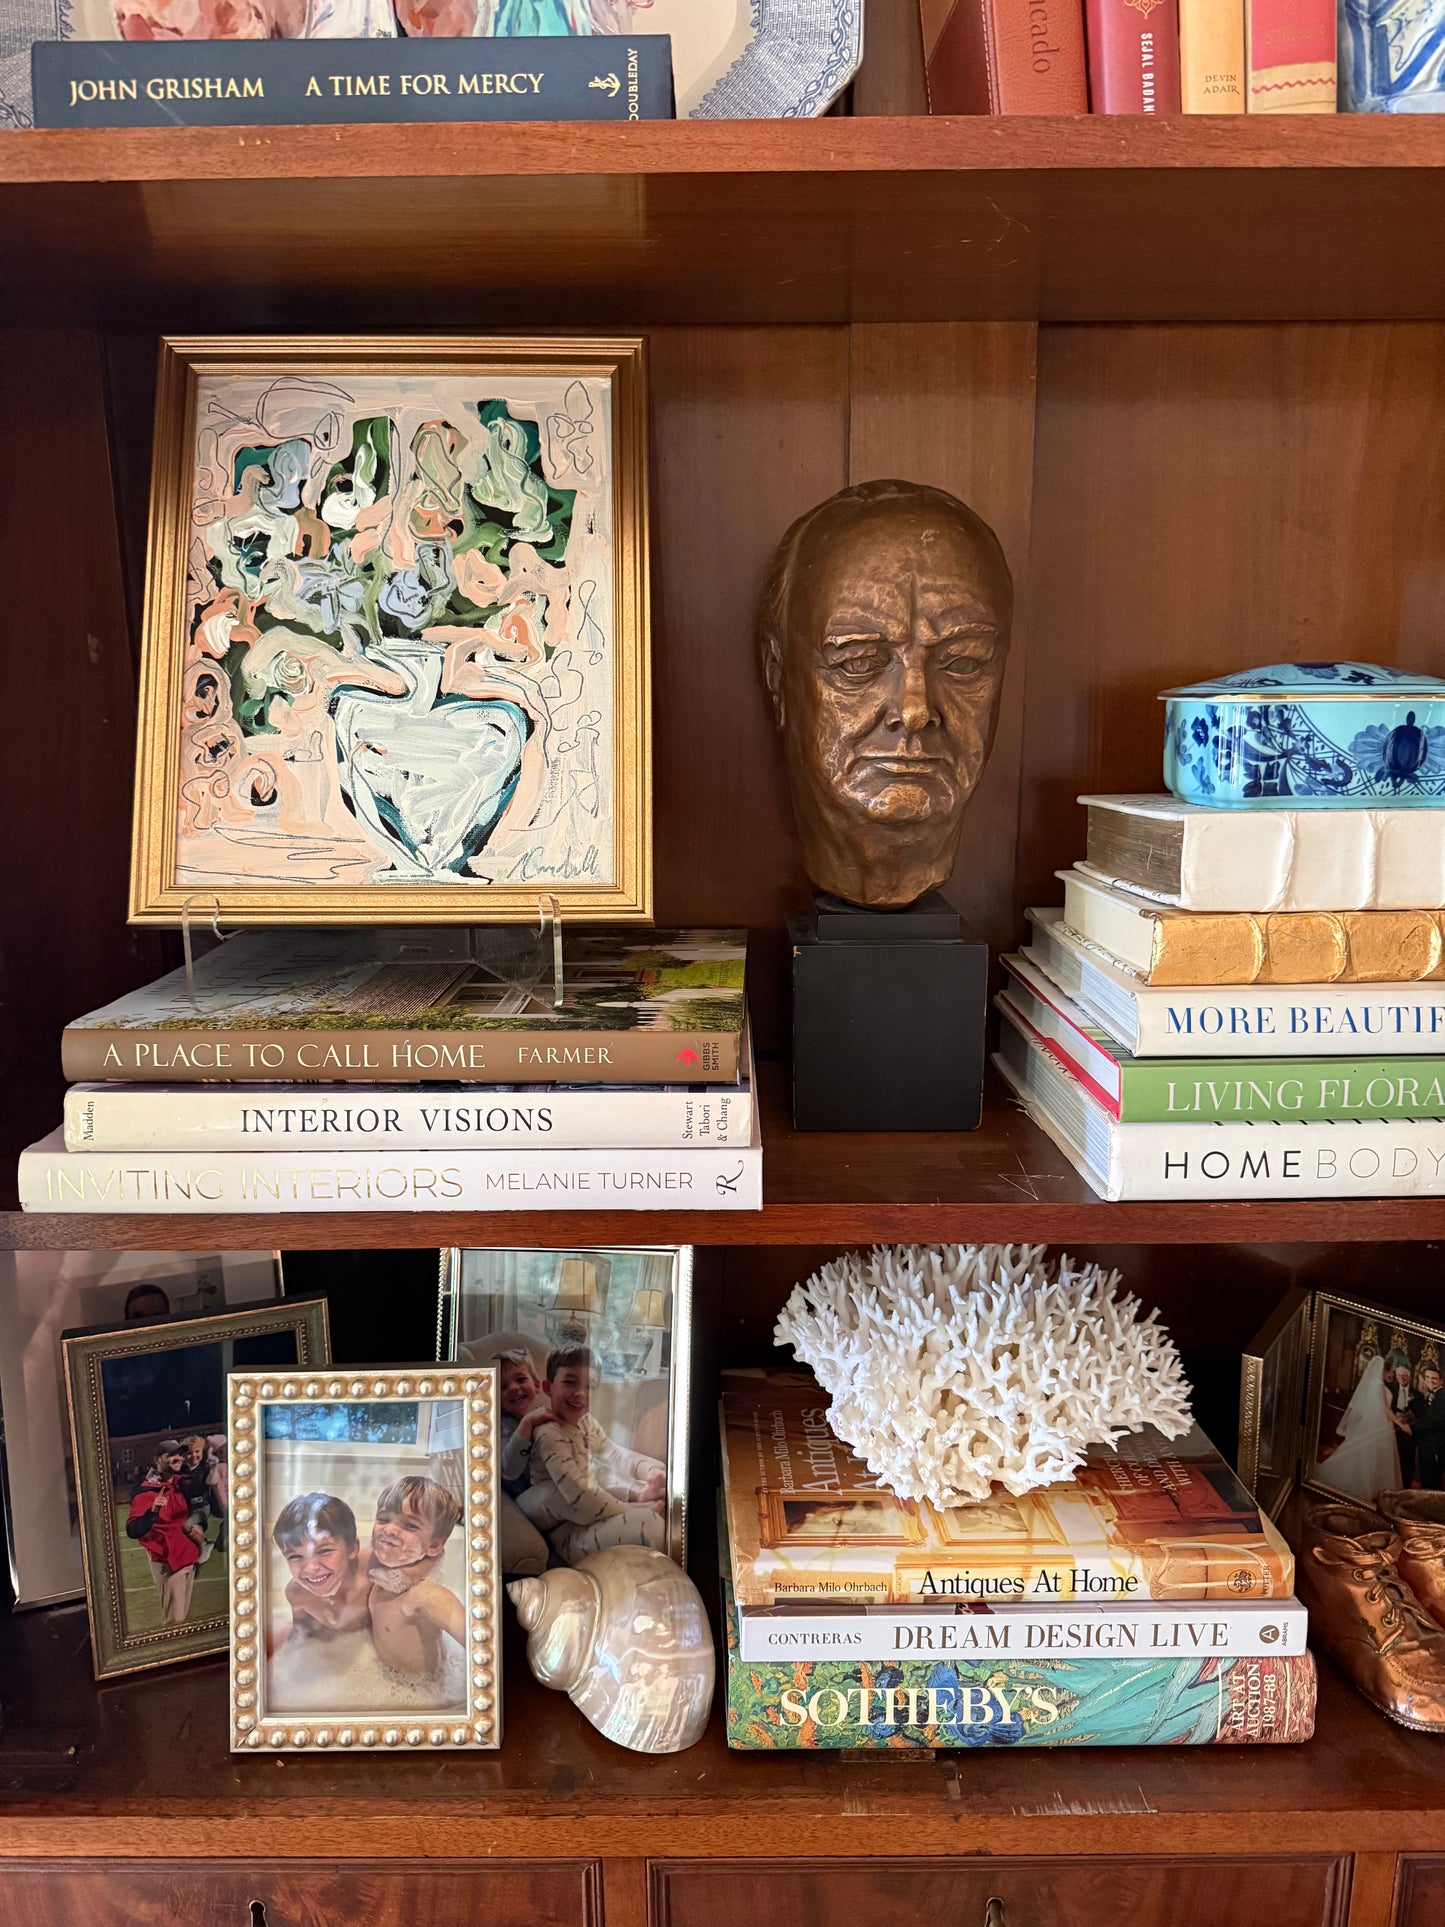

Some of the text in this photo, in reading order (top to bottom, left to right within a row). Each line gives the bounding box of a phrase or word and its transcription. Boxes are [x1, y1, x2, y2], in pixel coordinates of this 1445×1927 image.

[1029, 0, 1060, 73] cado
[1140, 32, 1154, 68] SEJAL
[70, 72, 545, 106] JOHN GRISHAM A TIME FOR MERCY
[627, 47, 639, 120] DOUBLEDAY
[1203, 85, 1241, 95] ADAIR
[1204, 74, 1237, 83] DEVIN
[1165, 1006, 1445, 1035] MORE BEAUTIF
[103, 1042, 614, 1068] A PLACE TO CALL HOME FARMER
[702, 1042, 711, 1071] GIBBS
[712, 1042, 720, 1071] SMITH
[1167, 1077, 1445, 1112] LIVING FLORA
[83, 1100, 95, 1141] Madden
[240, 1107, 554, 1133] INTERIOR VISIONS
[682, 1101, 693, 1140] Stewart
[699, 1104, 711, 1136] Tabori
[716, 1098, 731, 1142] & Chang
[46, 1167, 694, 1201] INVITING INTERIORS MELANIE TURNER
[769, 1410, 796, 1495] Barbara Milo Ohrbach
[797, 1407, 843, 1497] Antiques
[774, 1580, 888, 1593] Barbara Milo Ohrbach
[917, 1568, 1139, 1600] Antiques At Home
[1261, 1565, 1271, 1596] POTTER
[768, 1621, 1229, 1650] CONTRERAS DREAM DESIGN LIVE
[1281, 1621, 1289, 1646] ABRAMS
[779, 1686, 1060, 1728] SOTHEBY'S
[1231, 1670, 1246, 1732] ART AT
[1246, 1663, 1261, 1738] AUCTION
